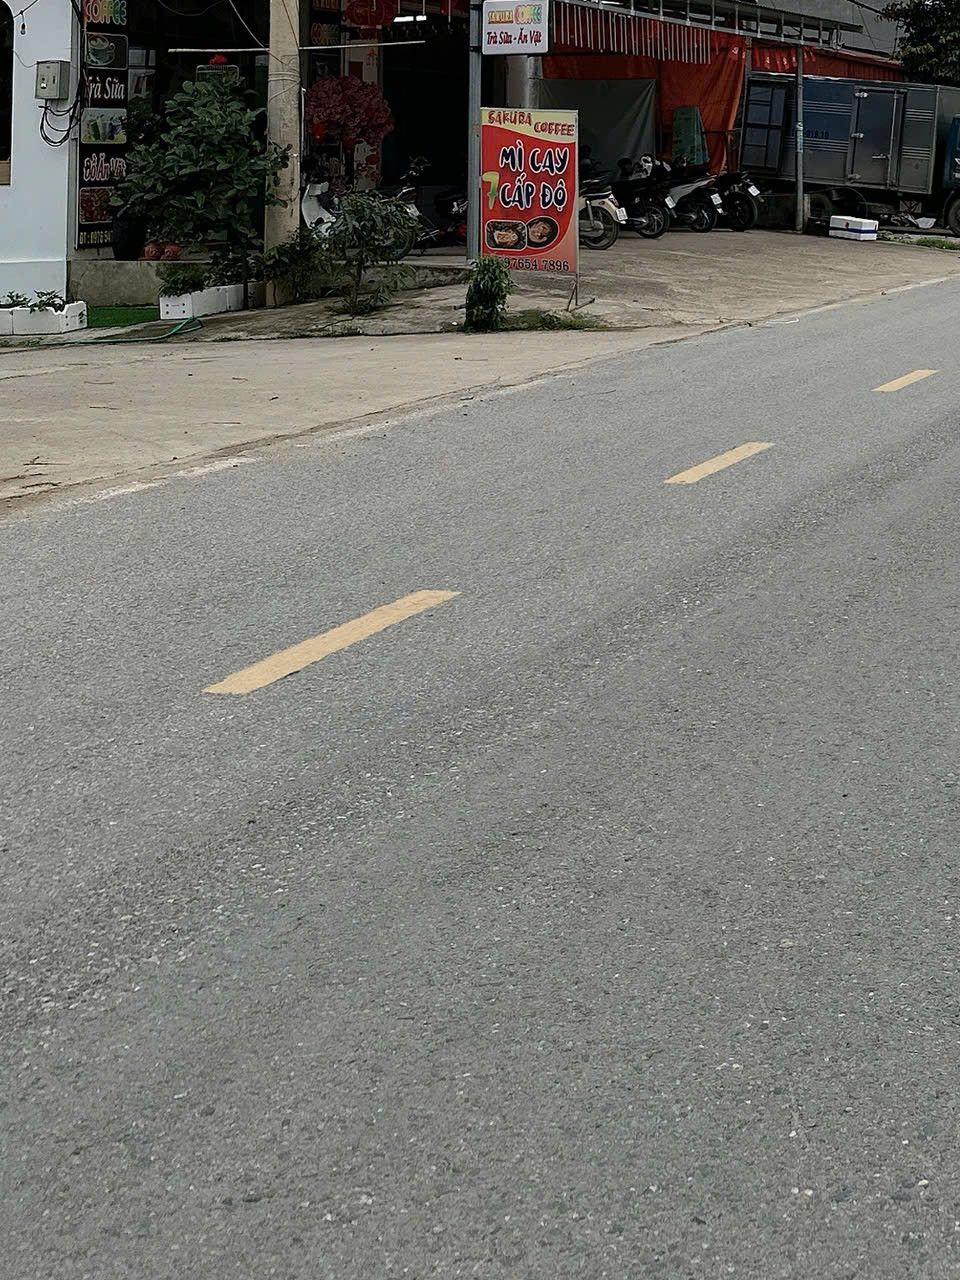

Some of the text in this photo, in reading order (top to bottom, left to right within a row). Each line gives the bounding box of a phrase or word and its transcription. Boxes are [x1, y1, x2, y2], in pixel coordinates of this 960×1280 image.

[487, 31, 498, 45] Trà
[518, 27, 528, 44] Ăn
[104, 76, 125, 100] Sữa
[487, 110, 575, 136] SAKURA COFFEE
[499, 139, 569, 176] MÌ CAY
[482, 171, 568, 212] 7 CẤP ĐỘ
[500, 257, 570, 272] 97654 7896
